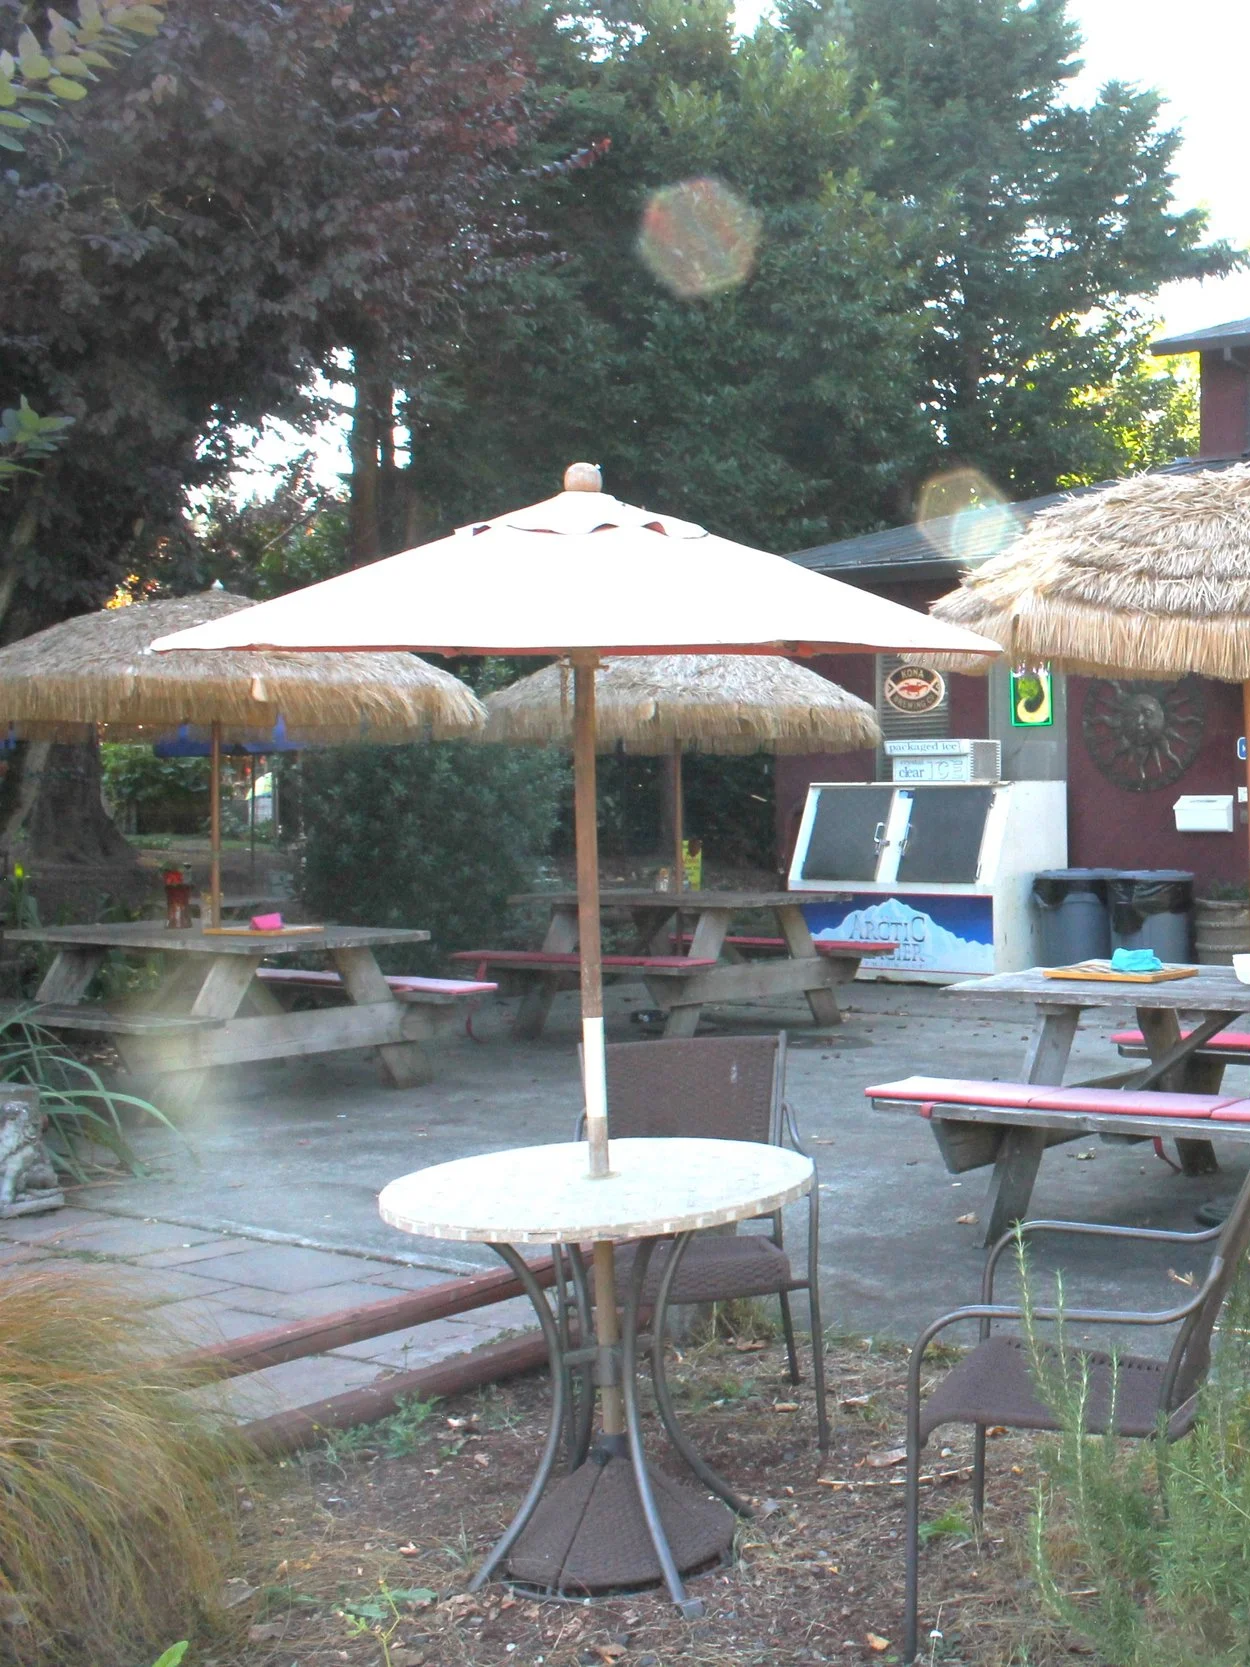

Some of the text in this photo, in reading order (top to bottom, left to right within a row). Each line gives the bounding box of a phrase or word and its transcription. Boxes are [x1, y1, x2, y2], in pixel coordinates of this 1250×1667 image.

[901, 669, 924, 679] KONA
[889, 741, 958, 752] packaged ice
[899, 766, 924, 778] clear
[849, 914, 926, 942] ARCTIC
